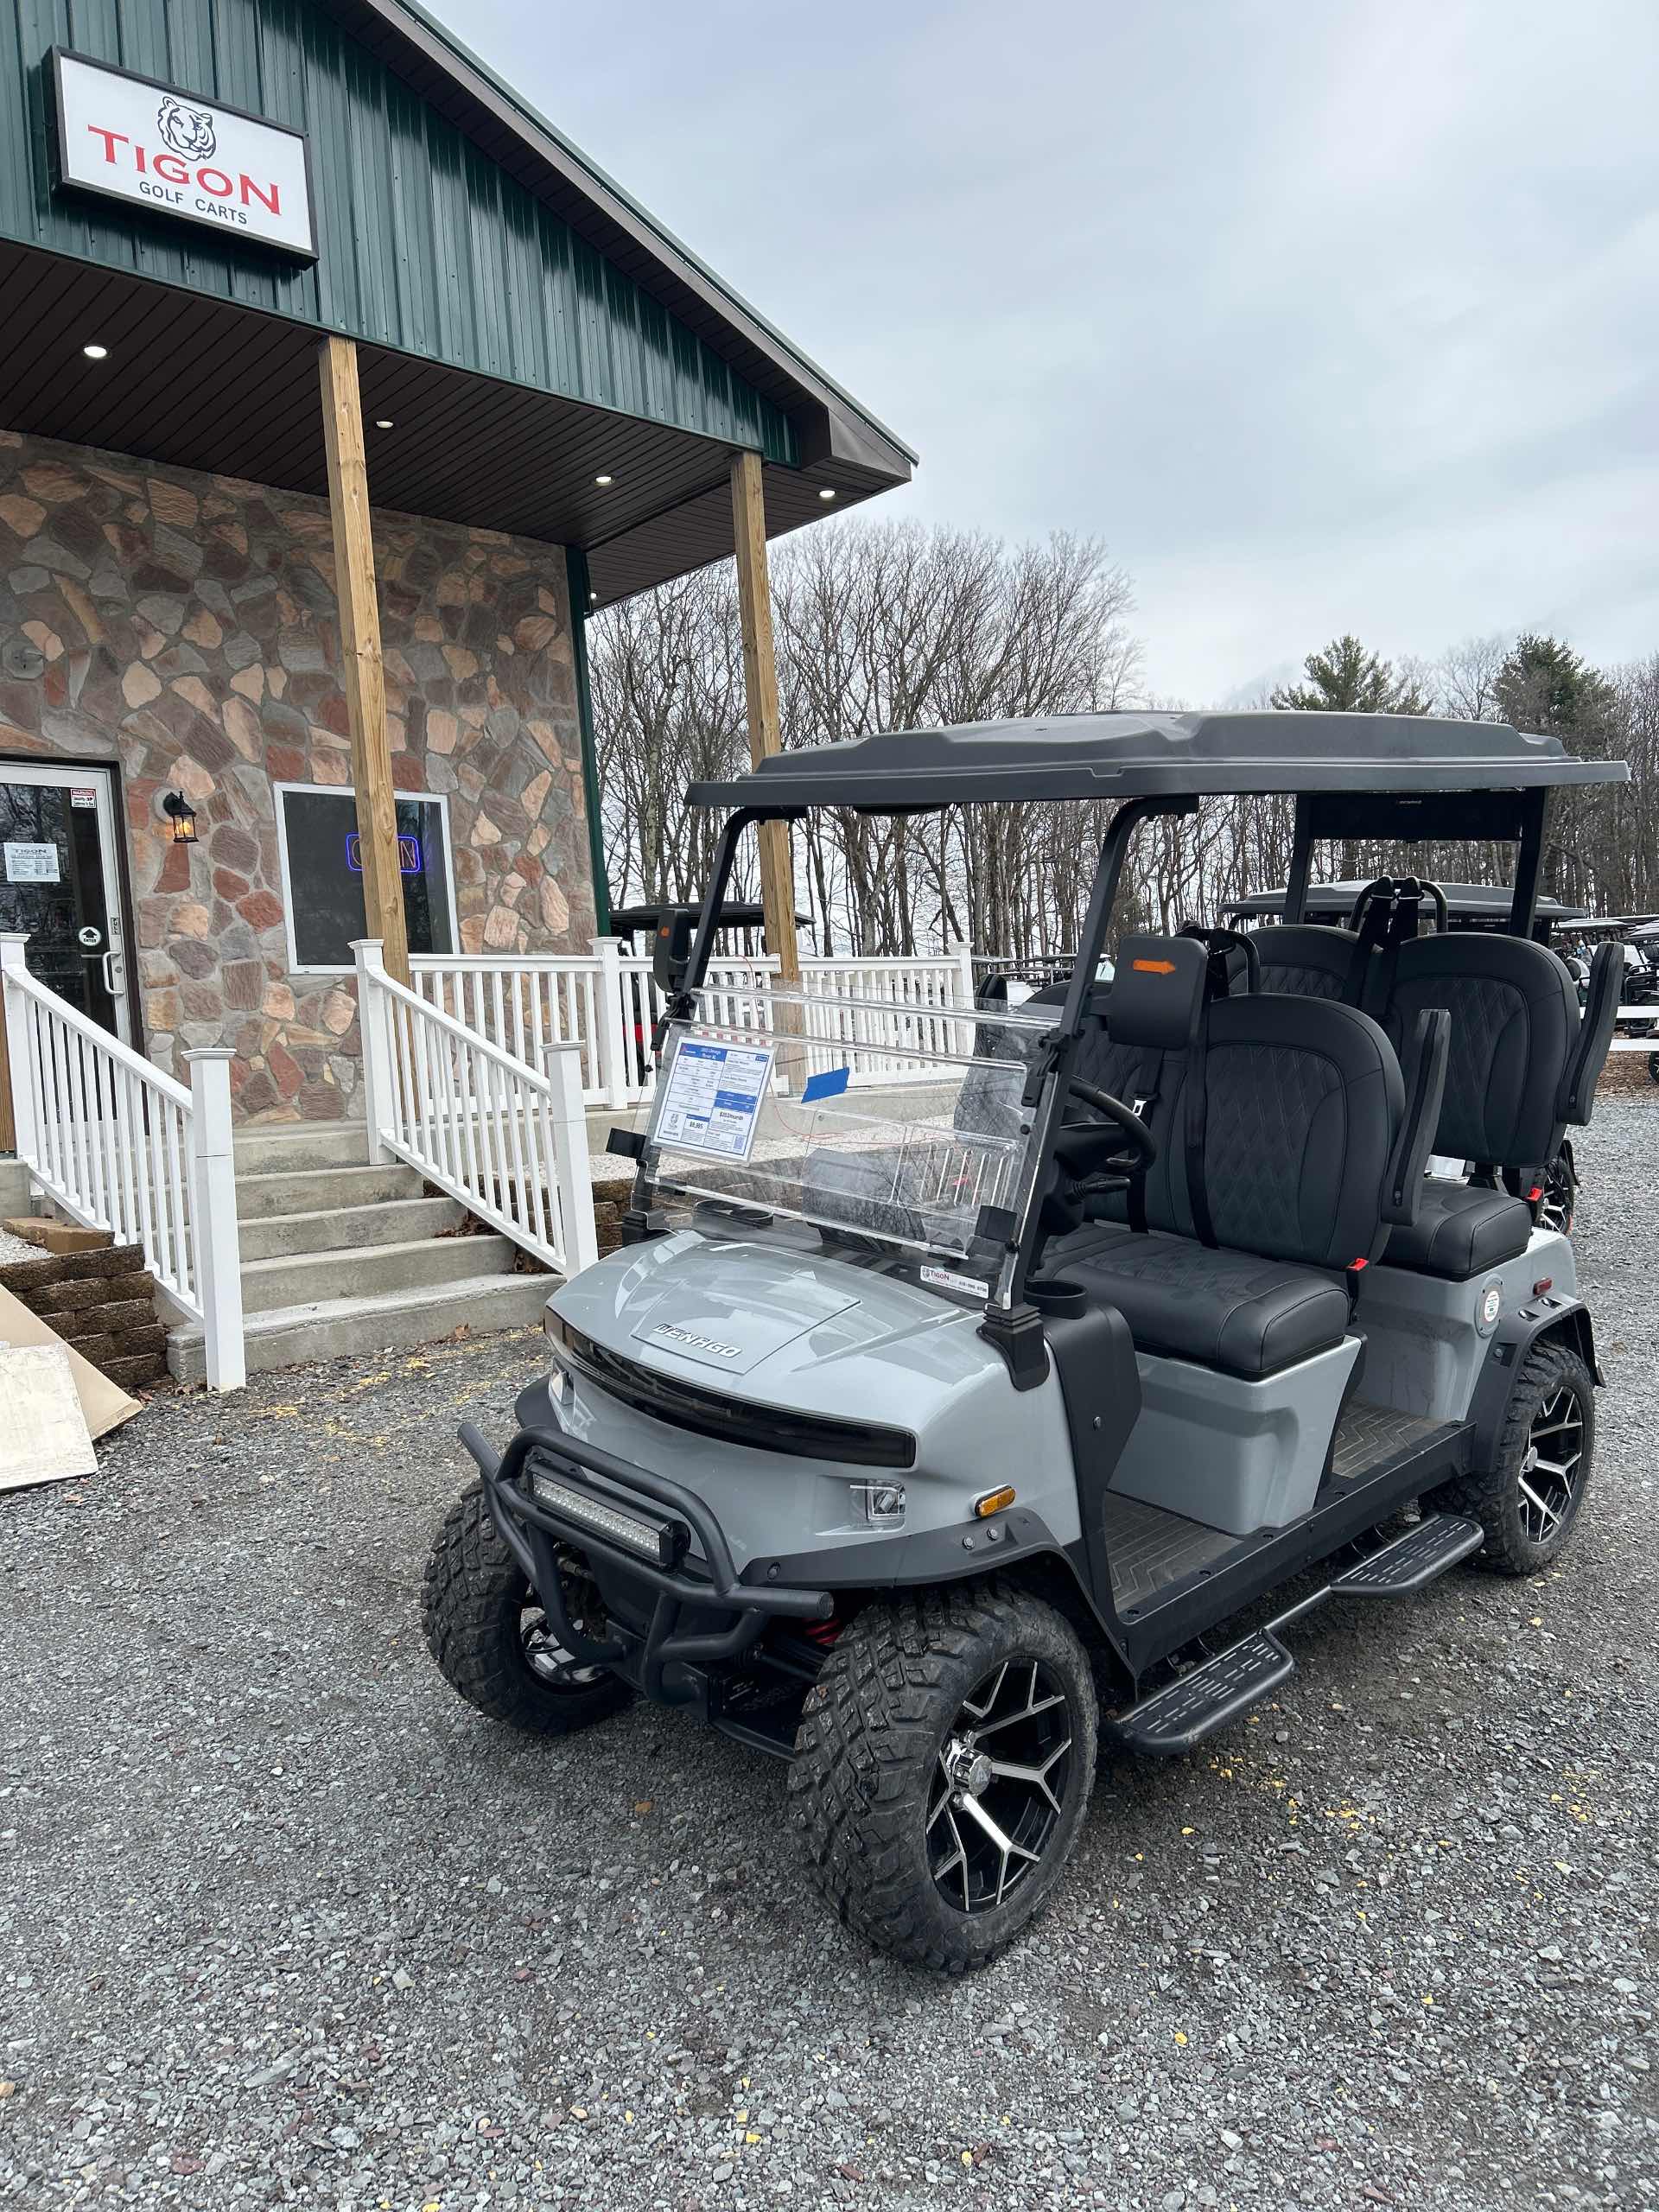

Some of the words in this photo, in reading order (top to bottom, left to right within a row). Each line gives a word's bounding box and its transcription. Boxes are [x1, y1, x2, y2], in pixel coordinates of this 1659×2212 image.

[87, 124, 282, 216] TIGON
[139, 181, 184, 204] GOLF
[194, 198, 248, 225] CARTS
[652, 1323, 742, 1358] DENAGO
